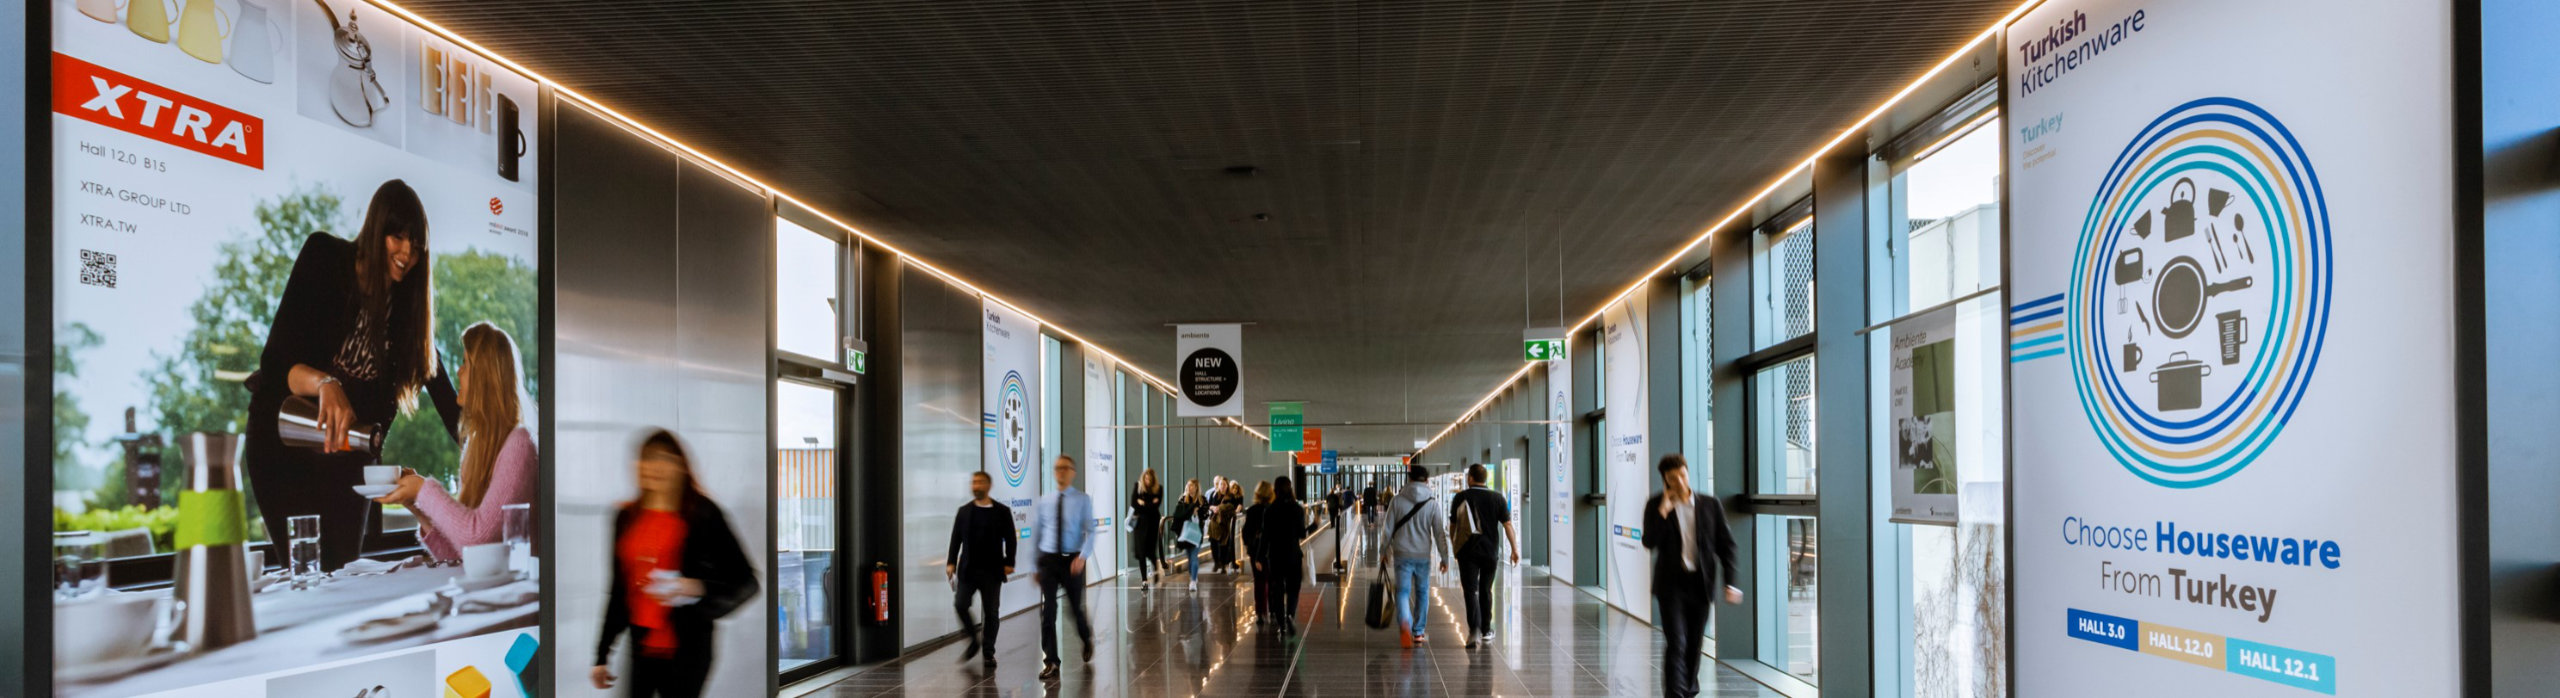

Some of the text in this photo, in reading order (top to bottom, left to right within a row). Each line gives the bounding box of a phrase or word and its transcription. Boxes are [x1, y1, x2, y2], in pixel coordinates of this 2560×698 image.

[2020, 9, 2086, 67] Turkish
[2021, 9, 2145, 98] Kitchenware
[80, 75, 248, 155] XTRA
[2020, 112, 2063, 144] Turkey
[80, 140, 167, 173] Hall 12.0 B15
[80, 180, 191, 215] XTRA GROUP LTD
[80, 213, 137, 234] XTRA.TW
[1894, 332, 1927, 351] Ambiente
[1195, 357, 1222, 368] NEW
[2063, 516, 2341, 569] Choose Houseware
[2101, 561, 2277, 623] From Turkey
[2078, 617, 2126, 640] HALL 3.0
[2149, 631, 2213, 658] HALL 12.0
[2239, 648, 2320, 682] HALL 12.1
